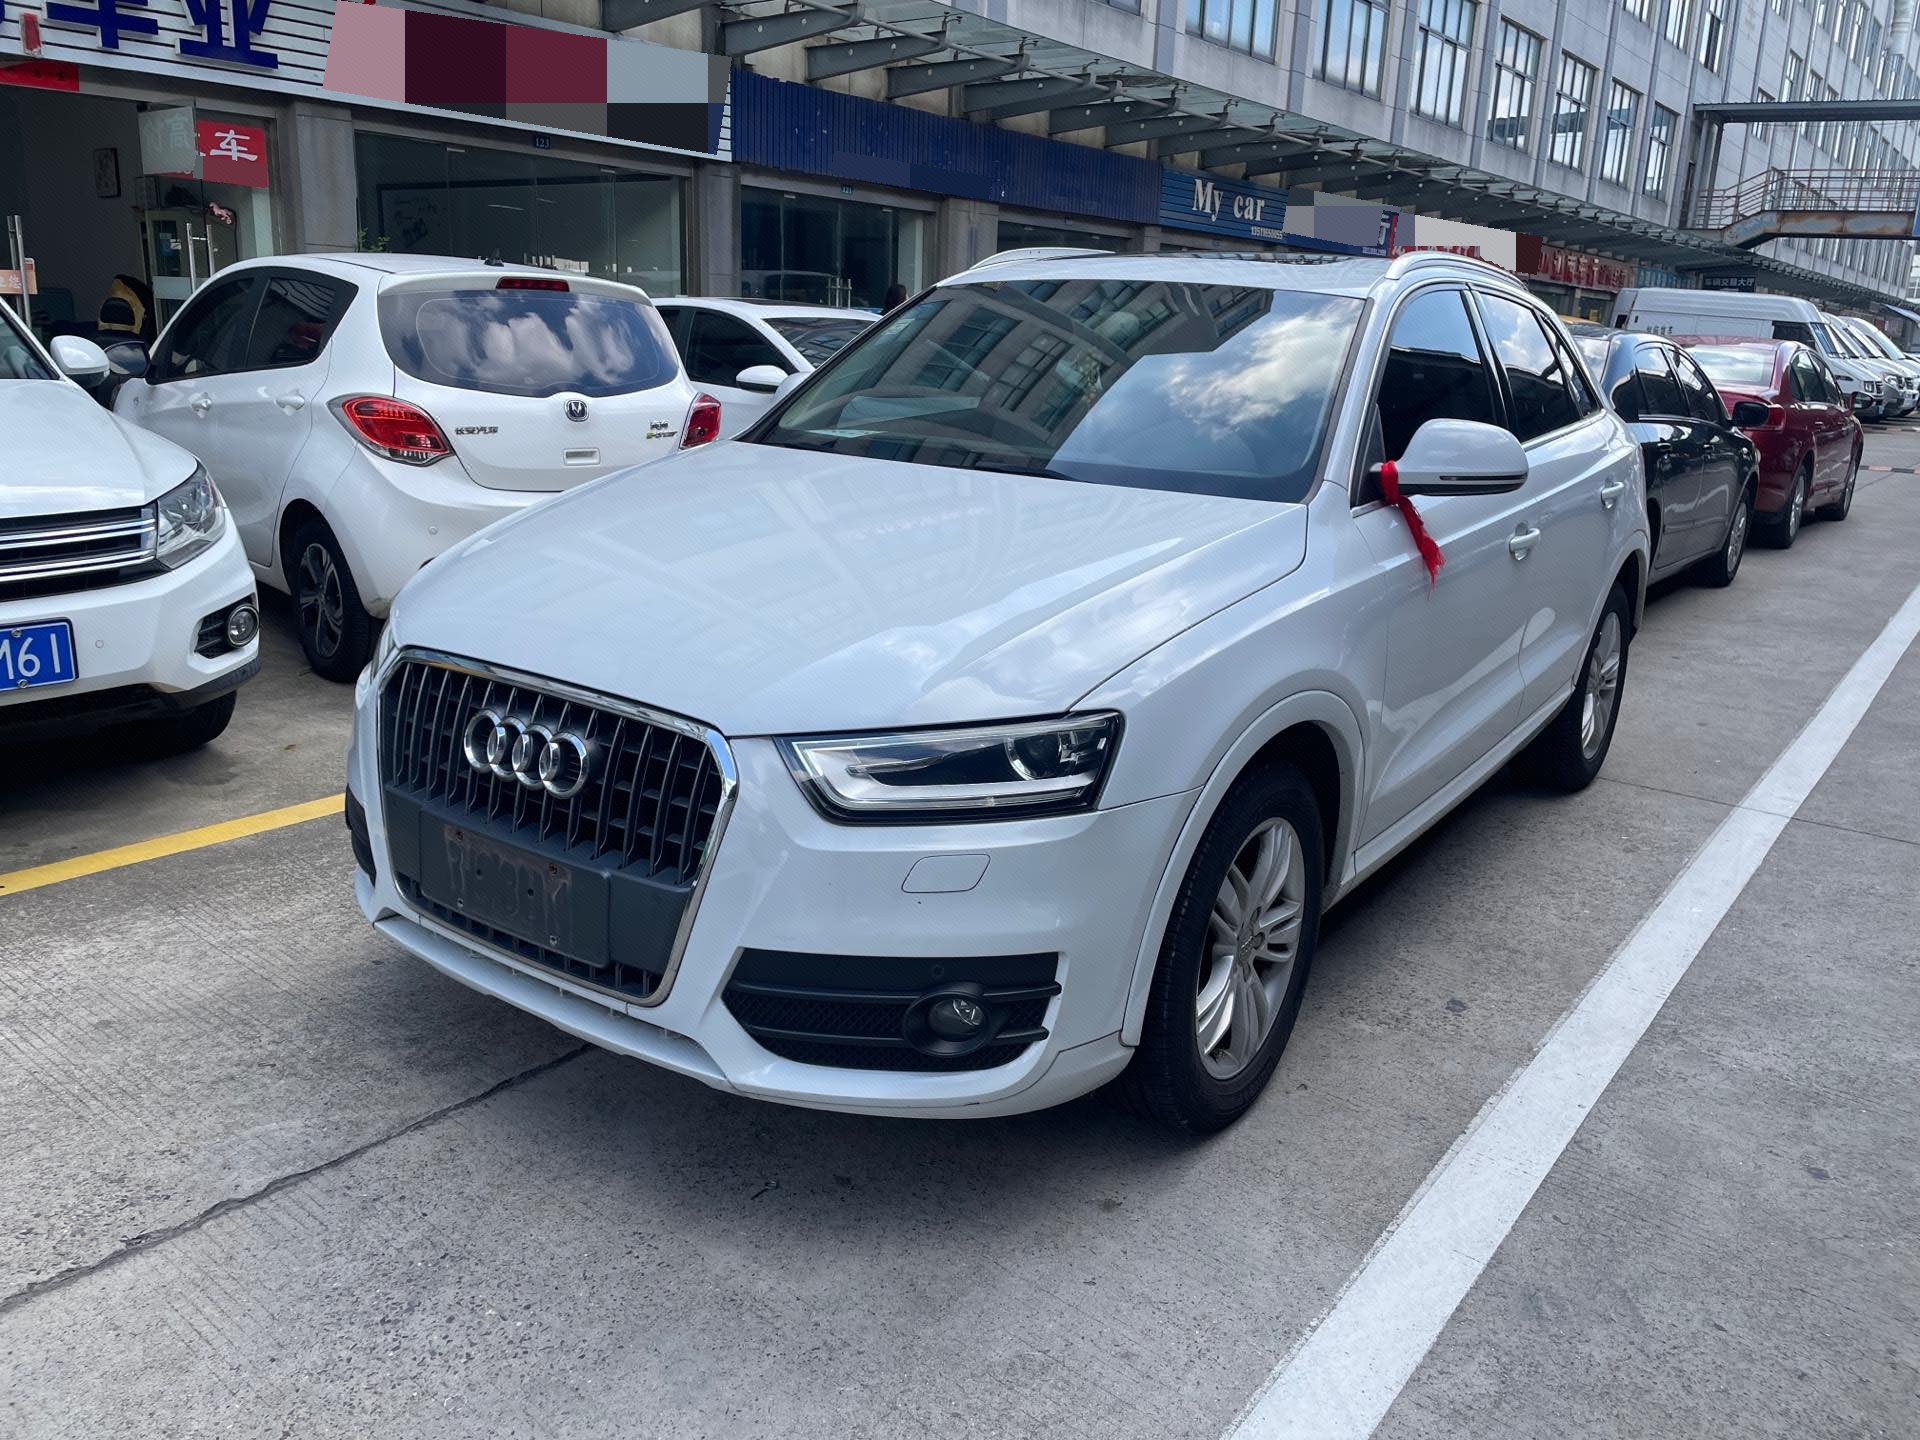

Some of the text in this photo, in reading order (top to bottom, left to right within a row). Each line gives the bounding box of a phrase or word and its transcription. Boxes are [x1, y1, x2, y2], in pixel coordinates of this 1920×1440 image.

[209, 129, 258, 161] 车
[1191, 178, 1266, 222] My car
